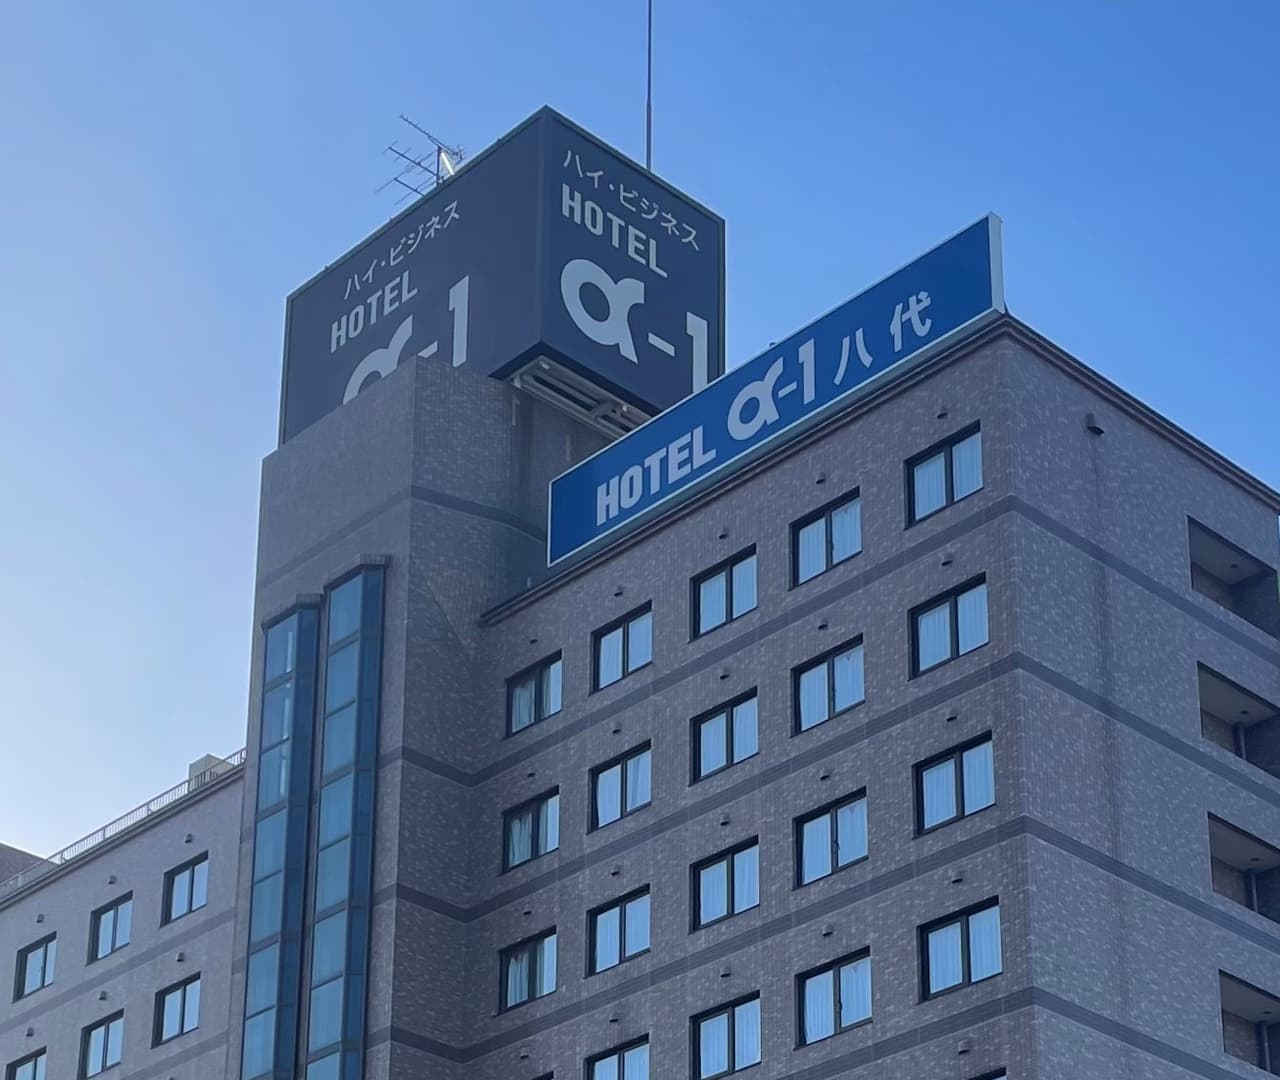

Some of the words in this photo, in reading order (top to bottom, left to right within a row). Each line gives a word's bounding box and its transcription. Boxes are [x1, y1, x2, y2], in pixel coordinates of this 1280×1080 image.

[344, 200, 459, 300] ハイ・ビジネス
[562, 184, 668, 278] HOTEL
[563, 150, 699, 250] ハイ・ビジネス
[331, 270, 417, 353] HOTEL
[560, 258, 708, 393] α-1
[596, 425, 716, 526] HOTEL
[727, 338, 816, 441] α-1
[834, 291, 931, 386] 八代
